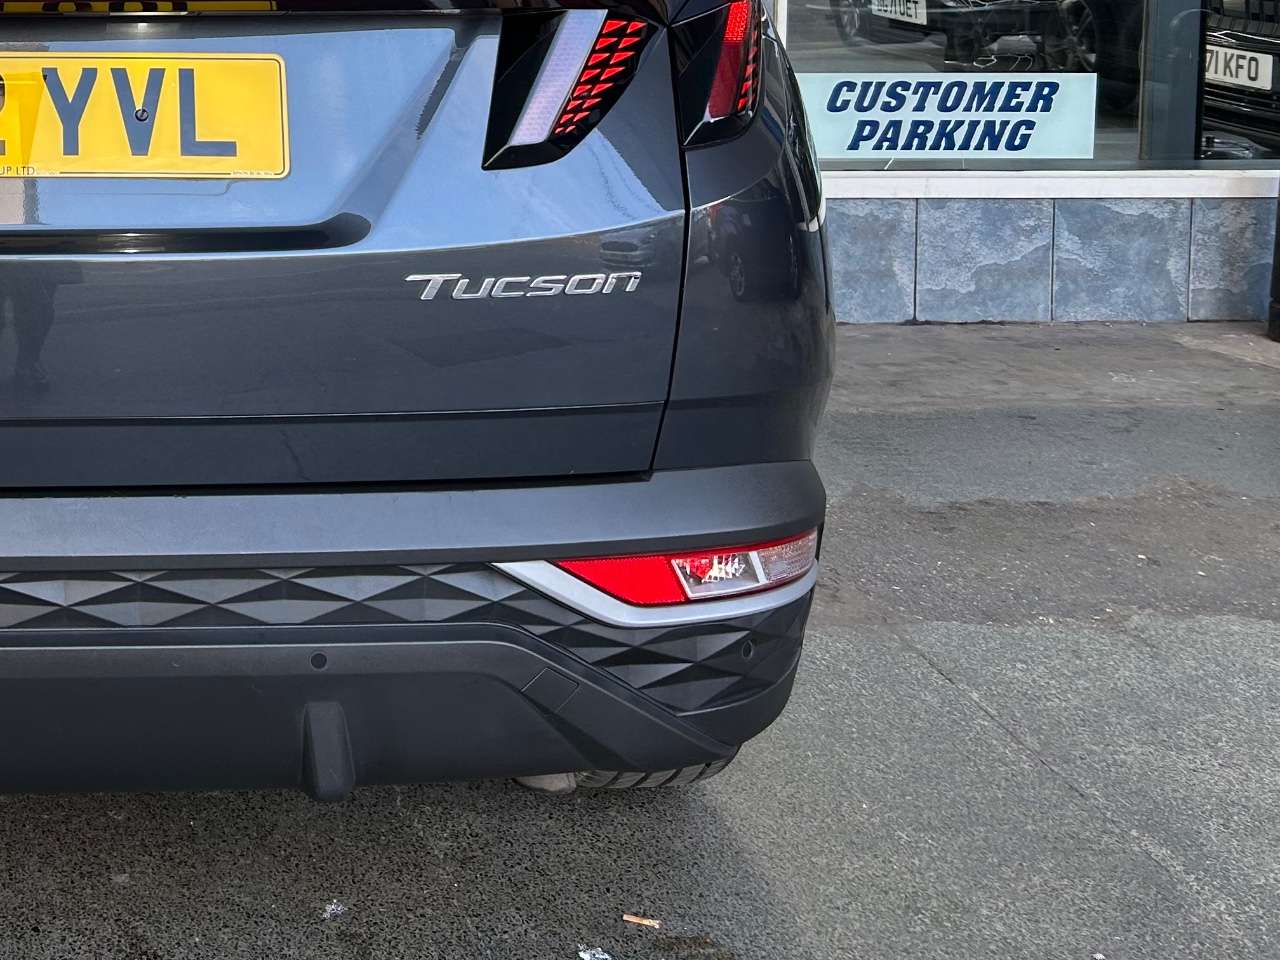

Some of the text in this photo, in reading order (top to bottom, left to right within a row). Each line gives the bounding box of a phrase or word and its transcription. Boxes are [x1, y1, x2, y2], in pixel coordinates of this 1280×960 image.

[1223, 51, 1259, 82] KFO
[41, 66, 237, 158] YVL
[826, 80, 1061, 113] CUSTOMER
[846, 119, 1037, 152] PARKING
[16, 166, 35, 176] LTD
